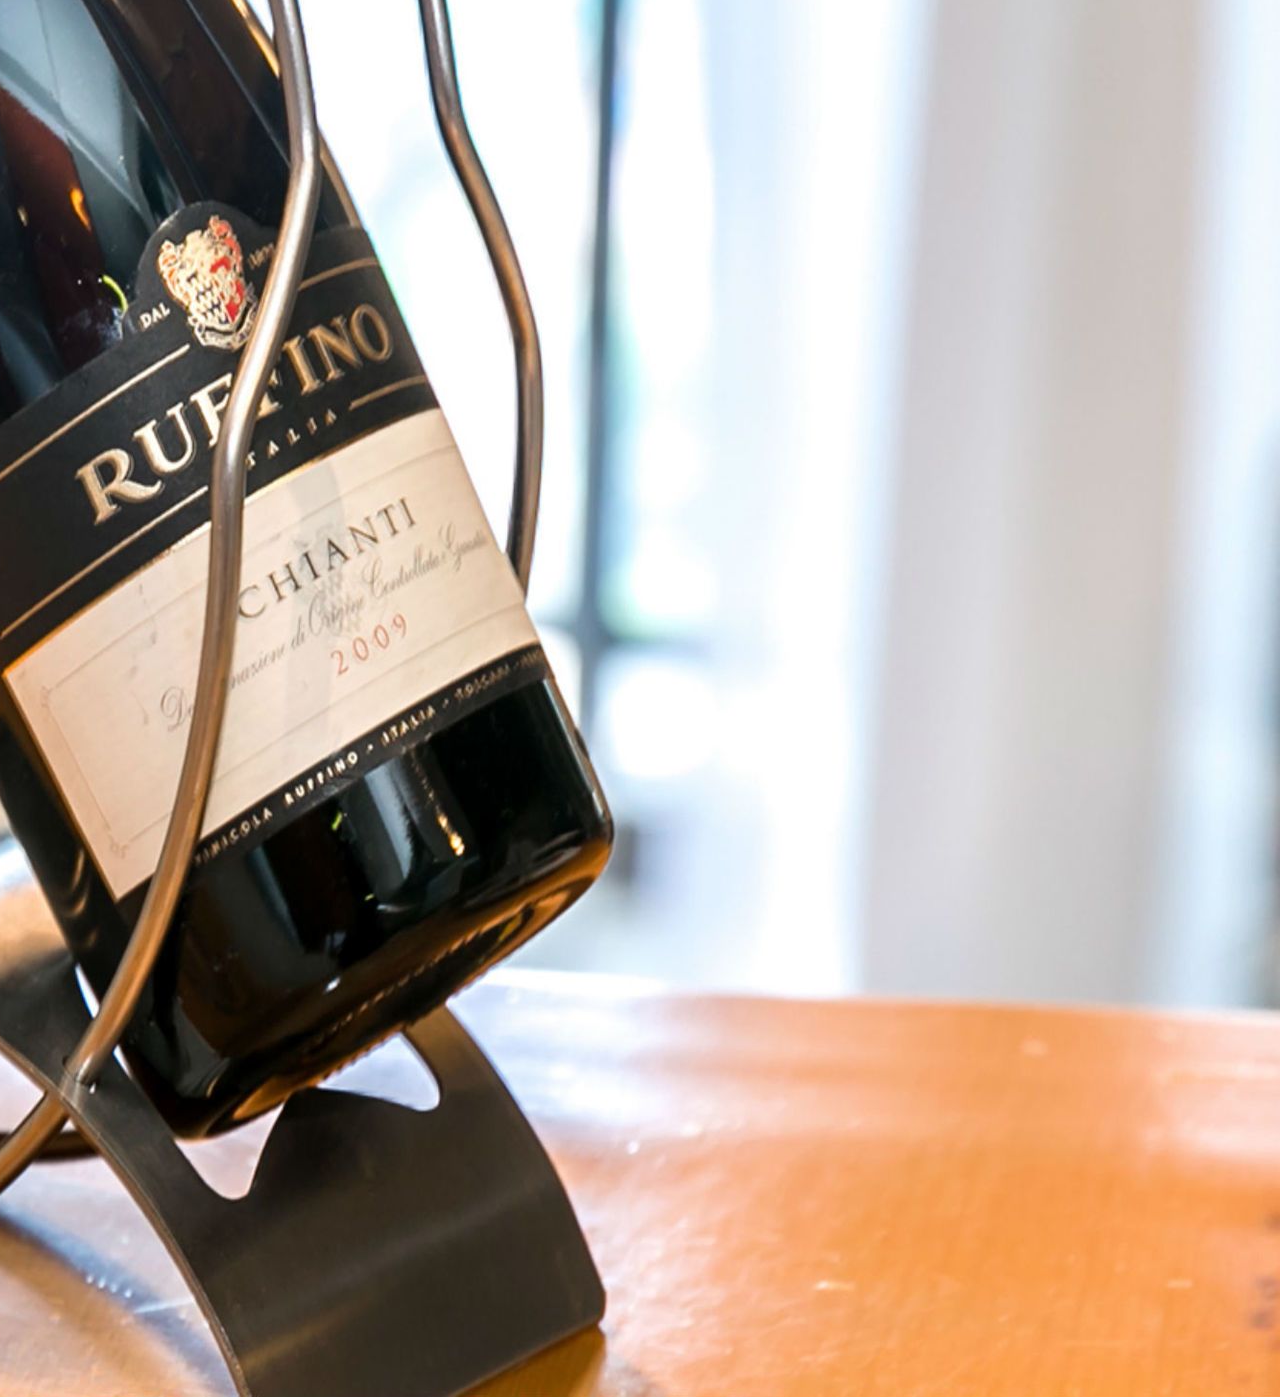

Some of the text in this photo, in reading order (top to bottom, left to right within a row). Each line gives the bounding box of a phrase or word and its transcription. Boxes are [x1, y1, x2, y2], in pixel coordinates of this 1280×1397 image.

[139, 302, 171, 330] DAL
[245, 408, 338, 471] TALIA
[237, 497, 417, 620] CHIANTI
[290, 615, 306, 650] di
[330, 613, 407, 676] 2009
[284, 750, 359, 807] RUFFINO
[380, 704, 437, 747] ITALIA
